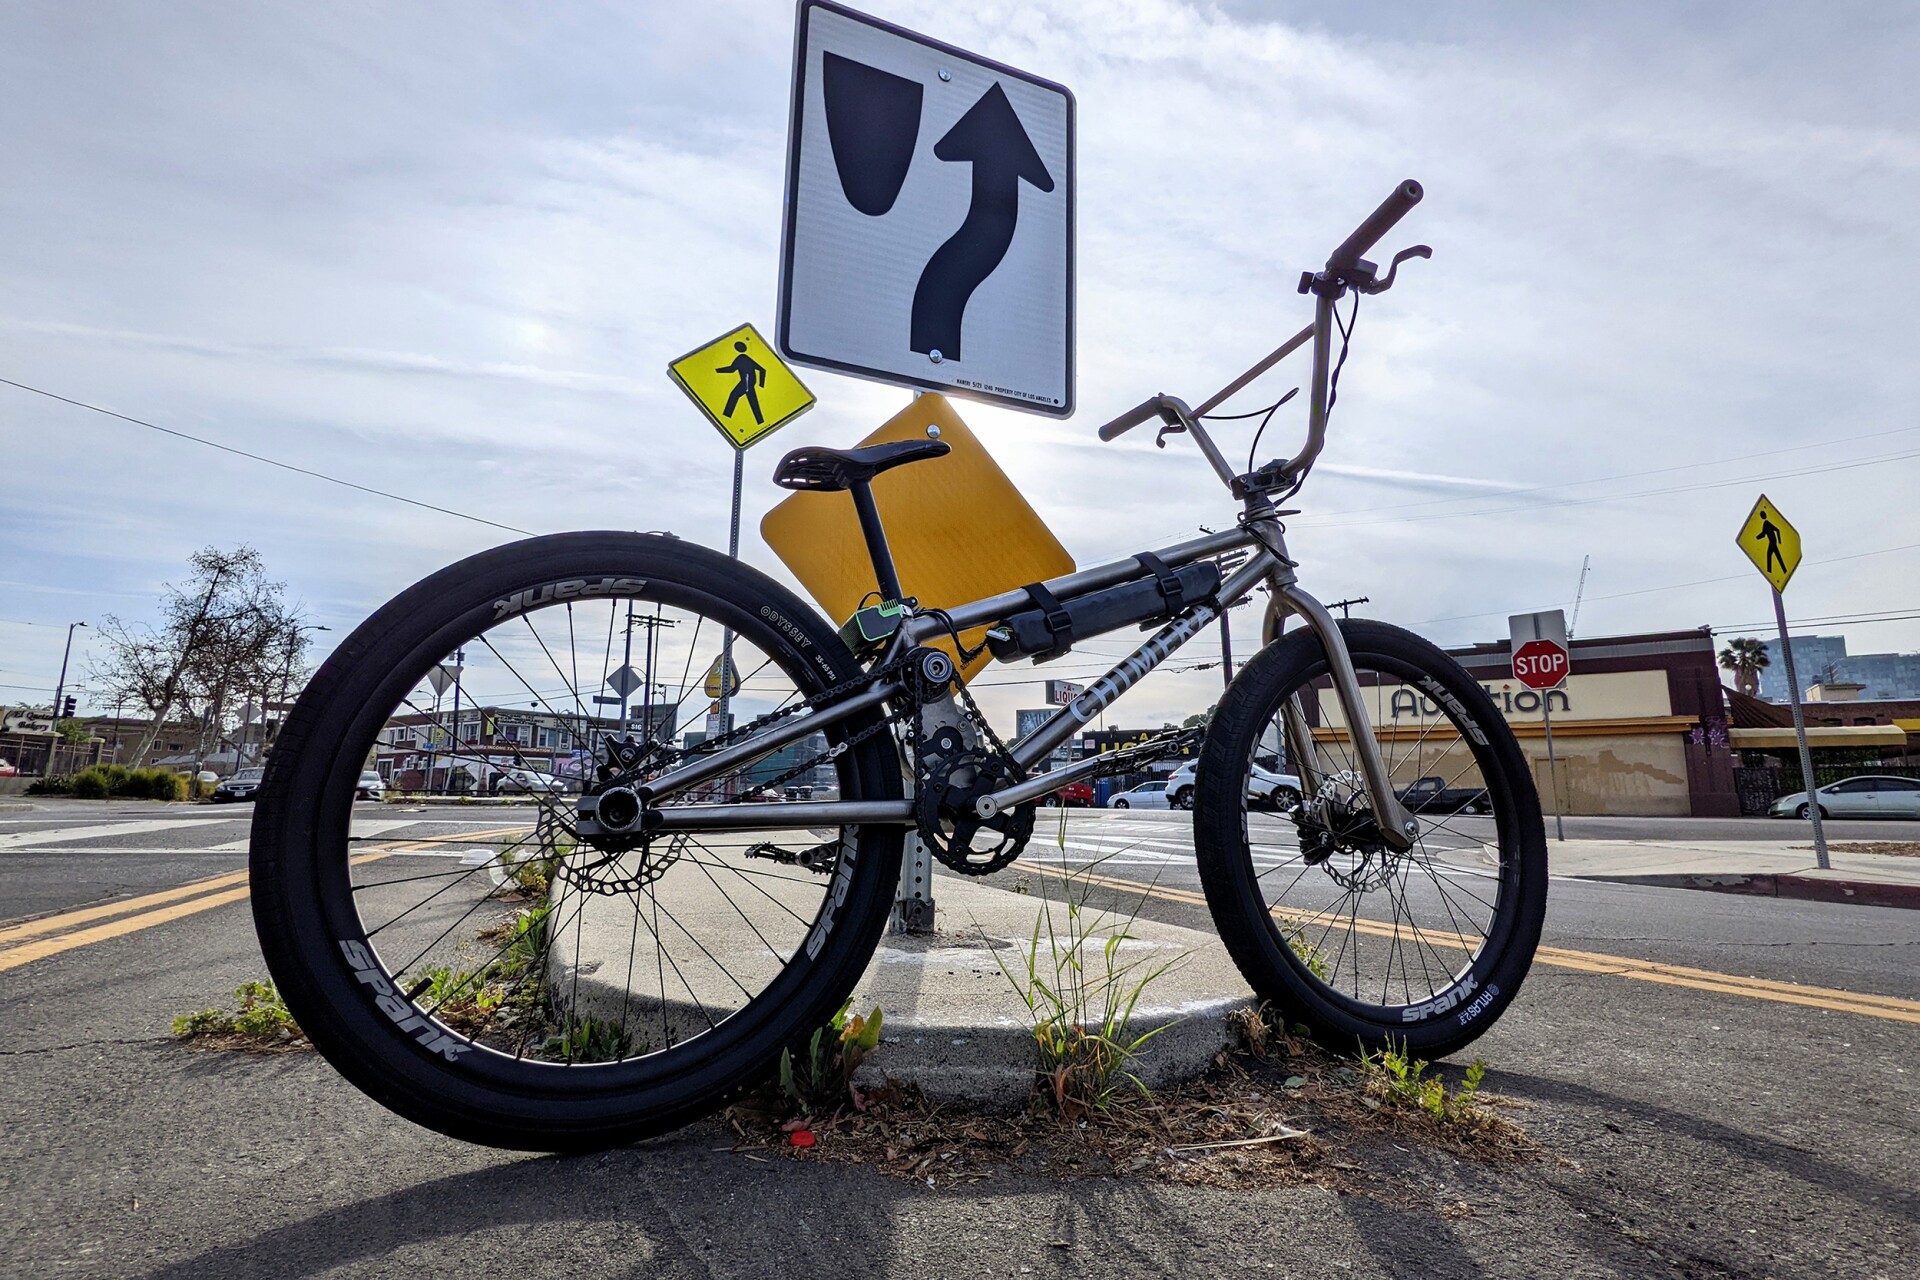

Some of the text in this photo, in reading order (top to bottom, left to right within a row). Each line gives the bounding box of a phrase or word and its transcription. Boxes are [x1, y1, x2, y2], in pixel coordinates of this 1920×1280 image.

[994, 386, 1014, 395] PROPERTY
[760, 605, 812, 648] ODYSSEY
[1070, 604, 1215, 723] CHIMERA
[1516, 653, 1565, 676] STOP
[1055, 690, 1078, 704] LIQU
[1391, 684, 1571, 719] Aution
[1467, 991, 1493, 1017] ATLAS
